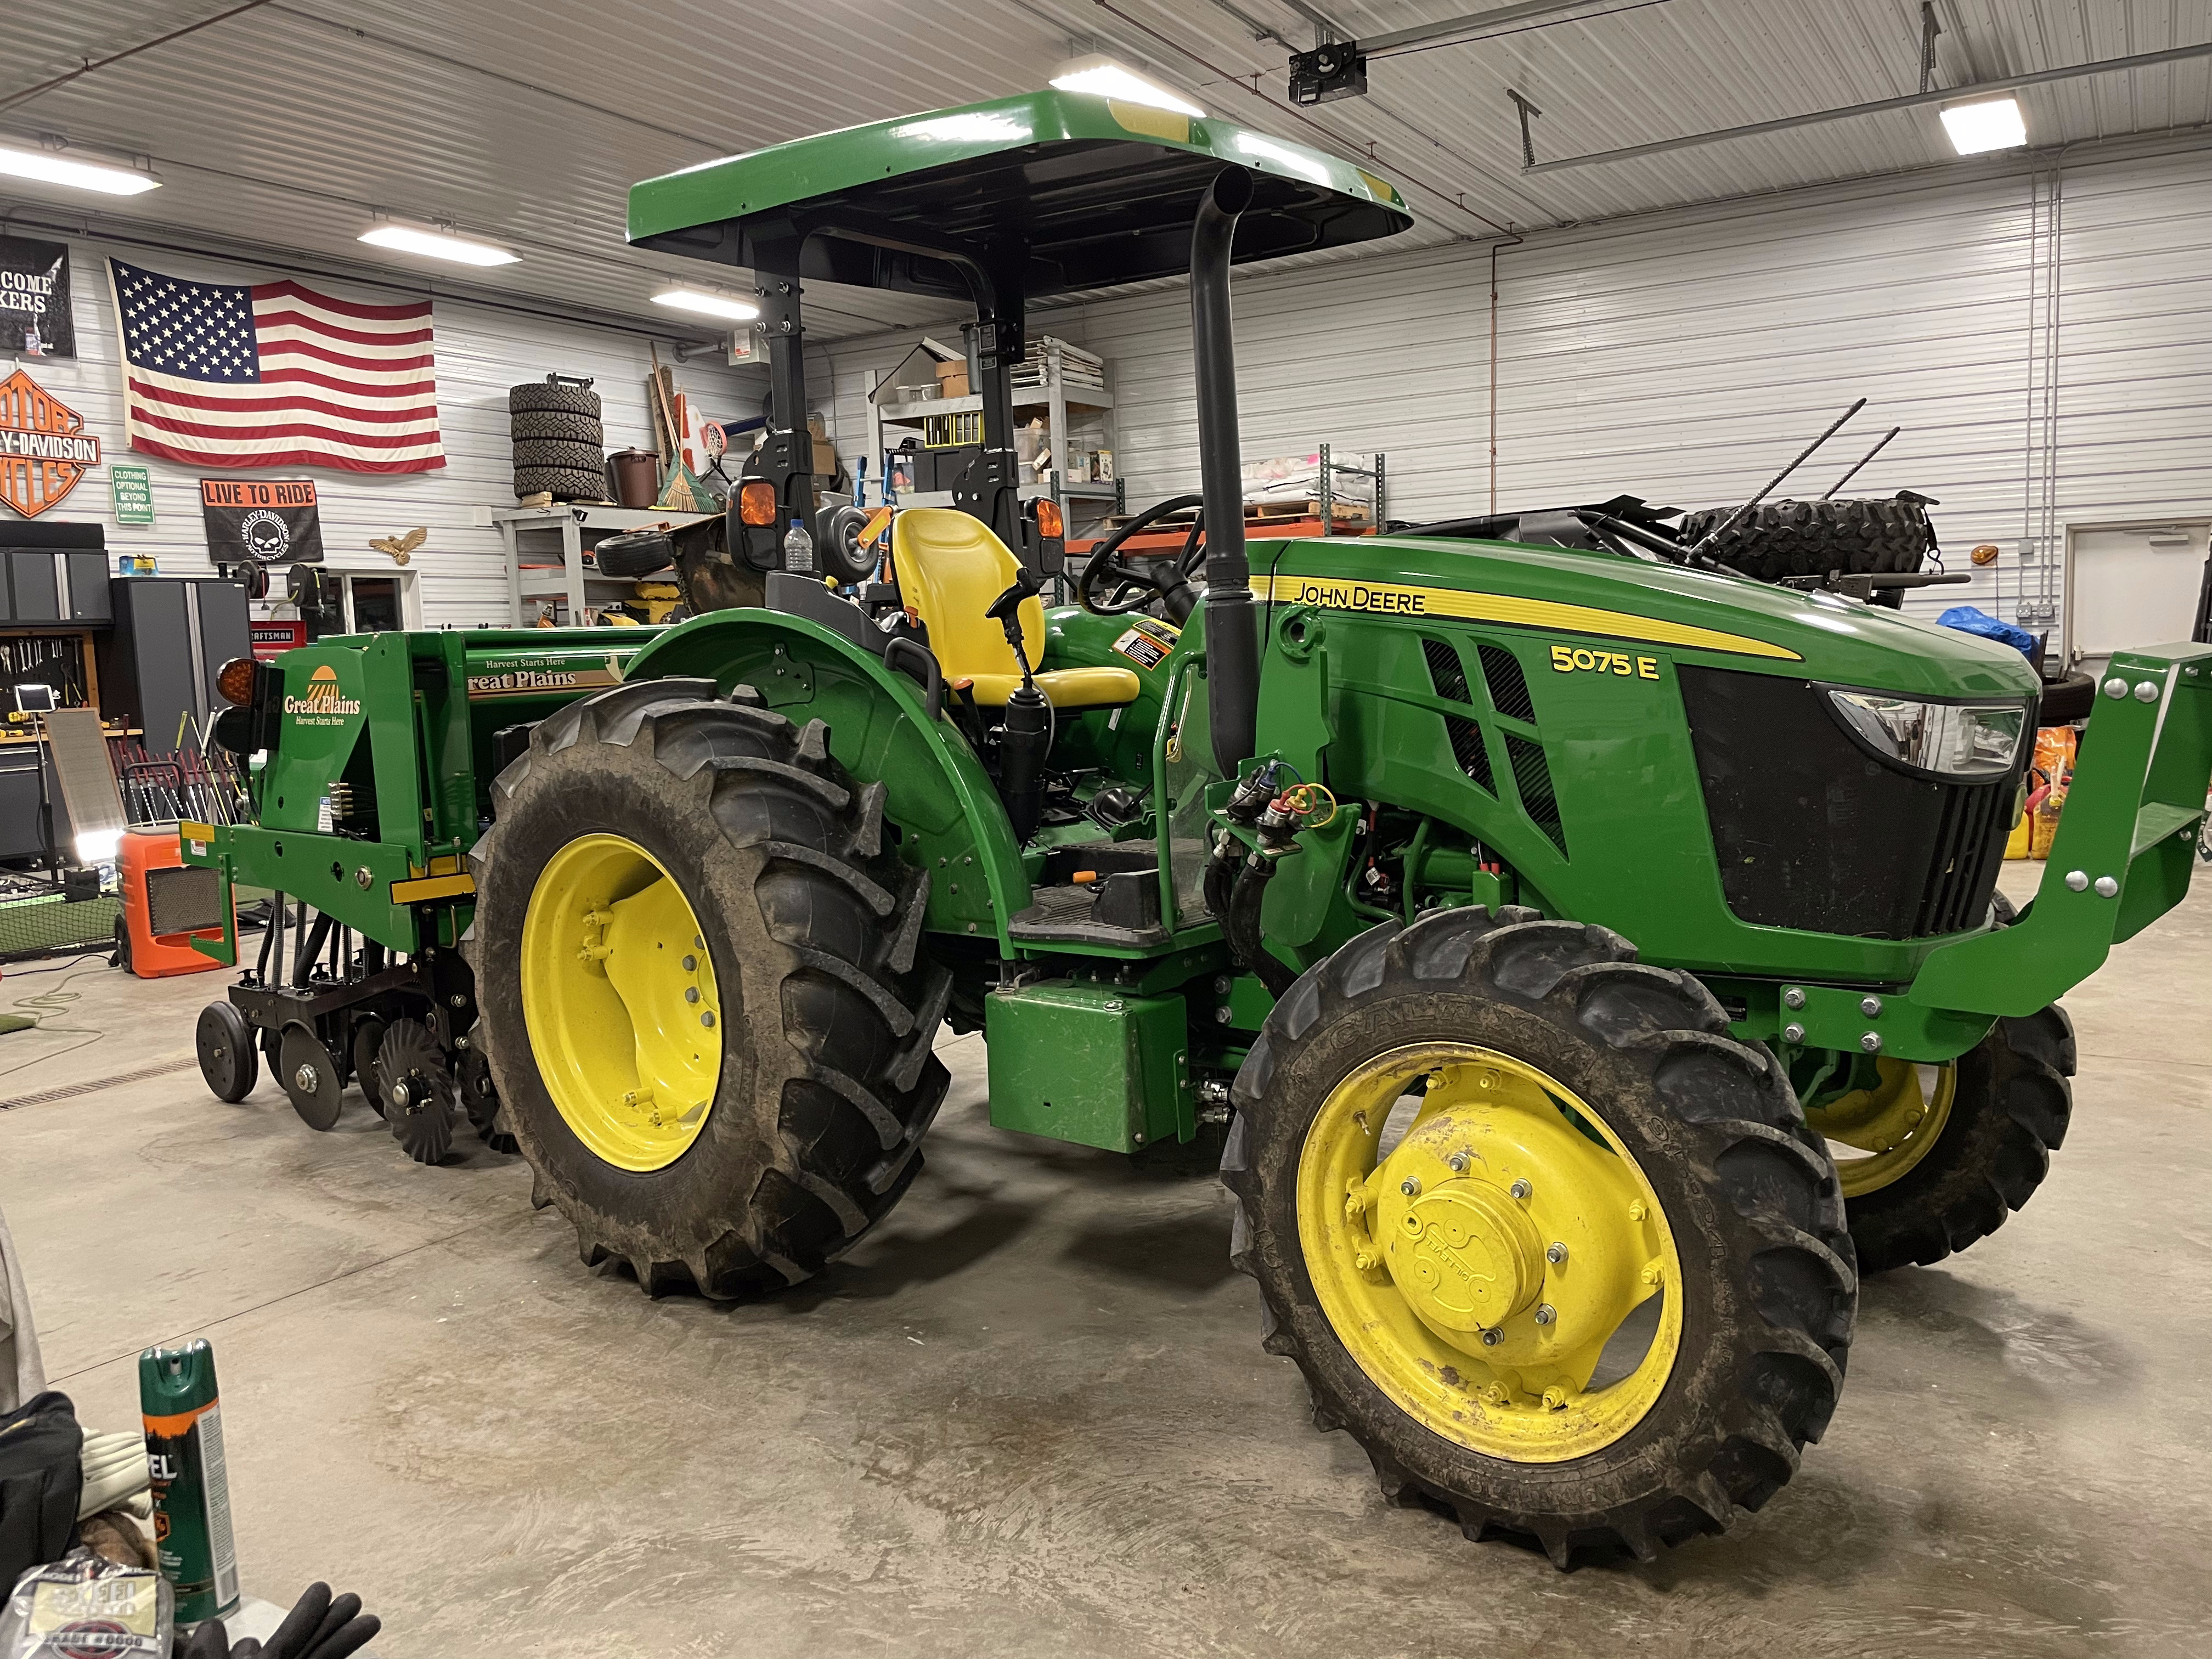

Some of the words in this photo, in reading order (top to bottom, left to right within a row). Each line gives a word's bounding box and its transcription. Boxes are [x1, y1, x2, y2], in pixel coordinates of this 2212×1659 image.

[0, 272, 52, 295] COME
[0, 430, 97, 462] Y-DAVIDSON
[114, 470, 146, 481] CLOTHING
[116, 481, 148, 491] OPTIONAL
[205, 483, 243, 504] LIVE
[247, 484, 270, 504] TO
[275, 484, 313, 504] RIDE
[120, 492, 146, 501] BEYOND
[117, 503, 132, 511] THIS
[132, 503, 151, 512] POINT
[246, 543, 289, 561] MOTORCYCLES
[1294, 582, 1348, 606] JOHN
[1353, 586, 1426, 612] DEERE
[486, 660, 518, 669] Harvest
[520, 659, 545, 667] Starts
[546, 658, 566, 666] Here
[1550, 645, 1633, 675] 5075
[1637, 656, 1660, 680] E
[514, 670, 577, 688] Plains
[284, 695, 320, 714] Great
[322, 695, 361, 715] Plains
[296, 716, 315, 725] Harvest
[315, 716, 331, 726] Starts
[331, 716, 345, 726] Here
[1426, 1234, 1455, 1268] LEVEL
